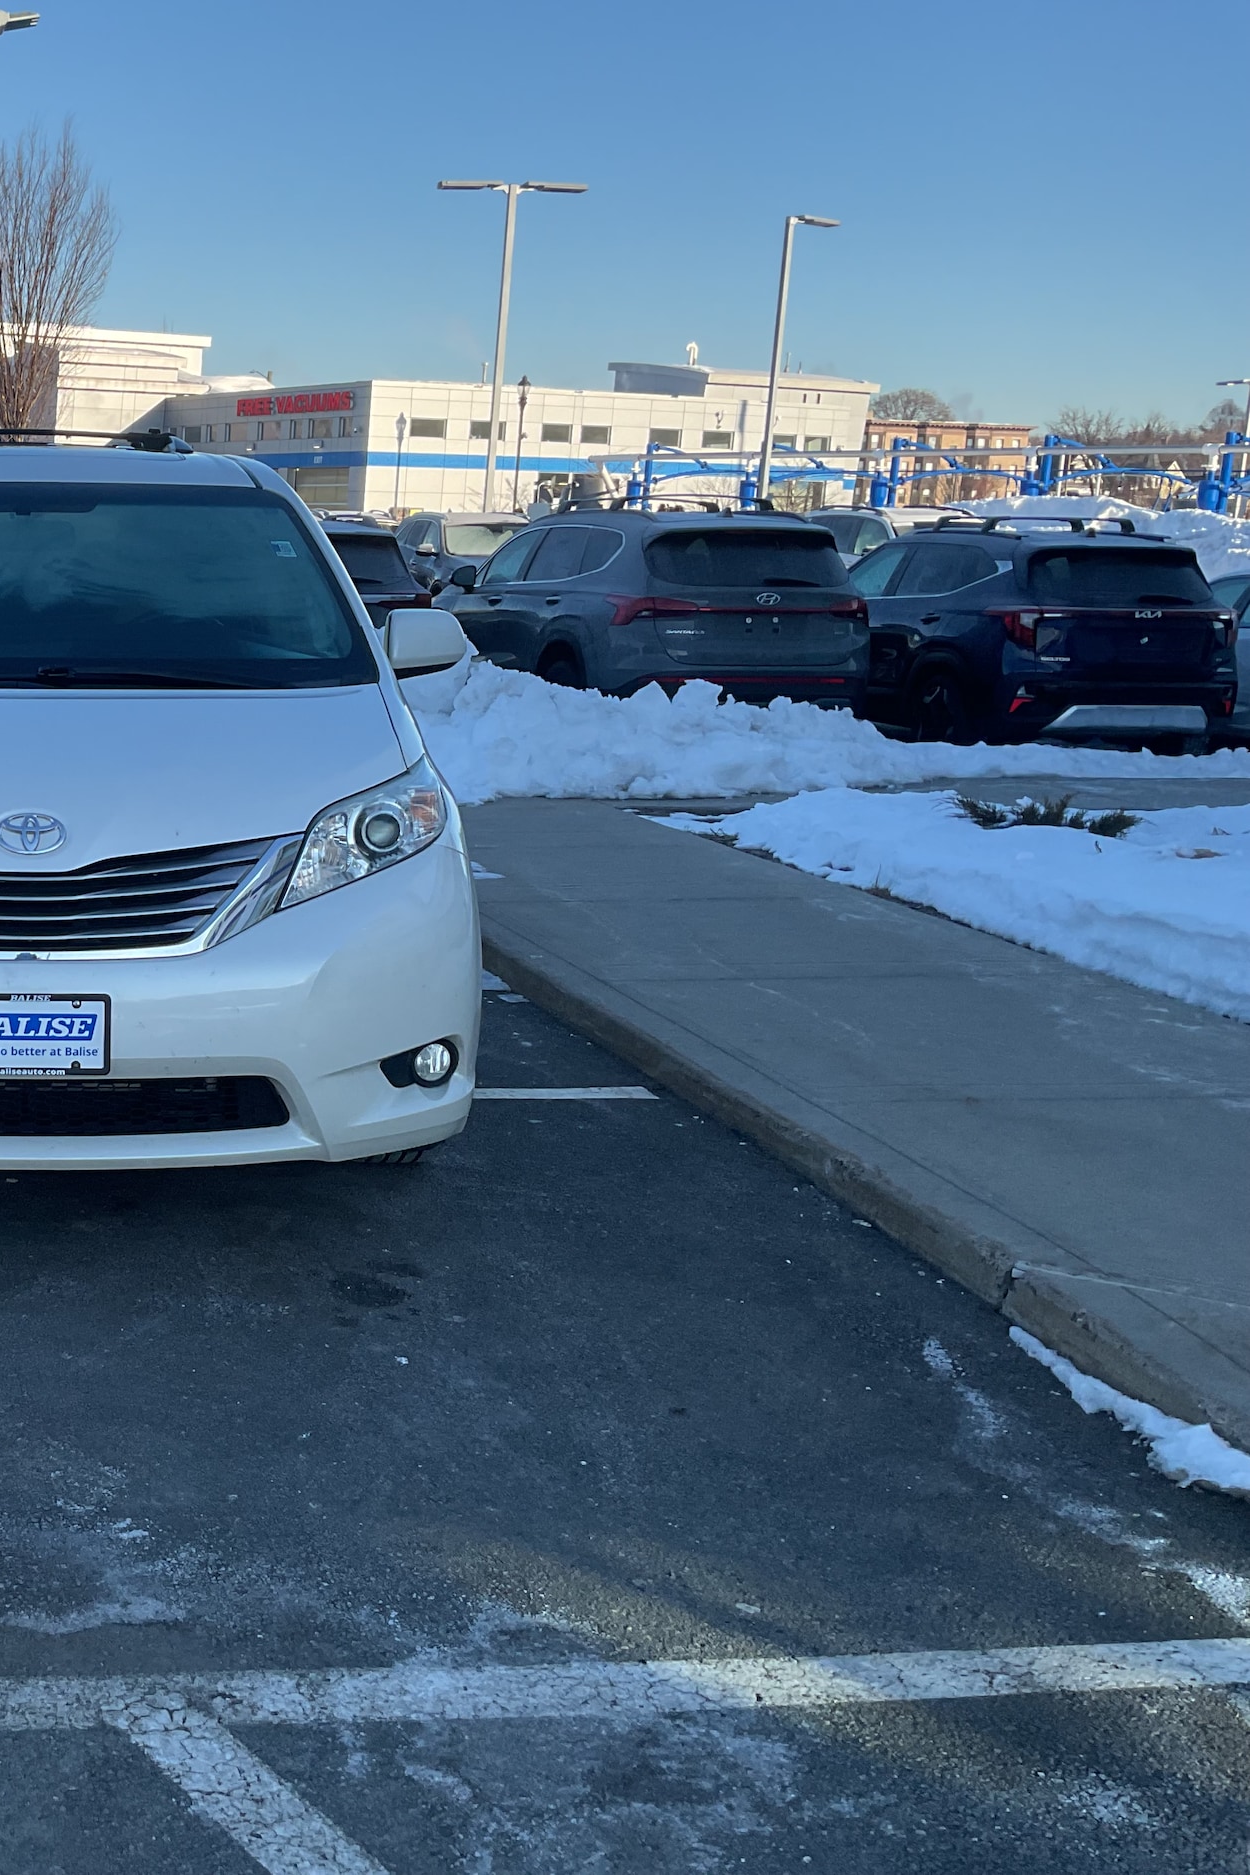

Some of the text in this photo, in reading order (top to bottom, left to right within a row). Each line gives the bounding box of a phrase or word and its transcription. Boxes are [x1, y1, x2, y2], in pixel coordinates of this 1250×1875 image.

[236, 391, 354, 416] FREE VACUUMS
[10, 994, 51, 1002] BALISE
[11, 1046, 47, 1056] better
[50, 1047, 62, 1056] at
[65, 1047, 98, 1056] Balise
